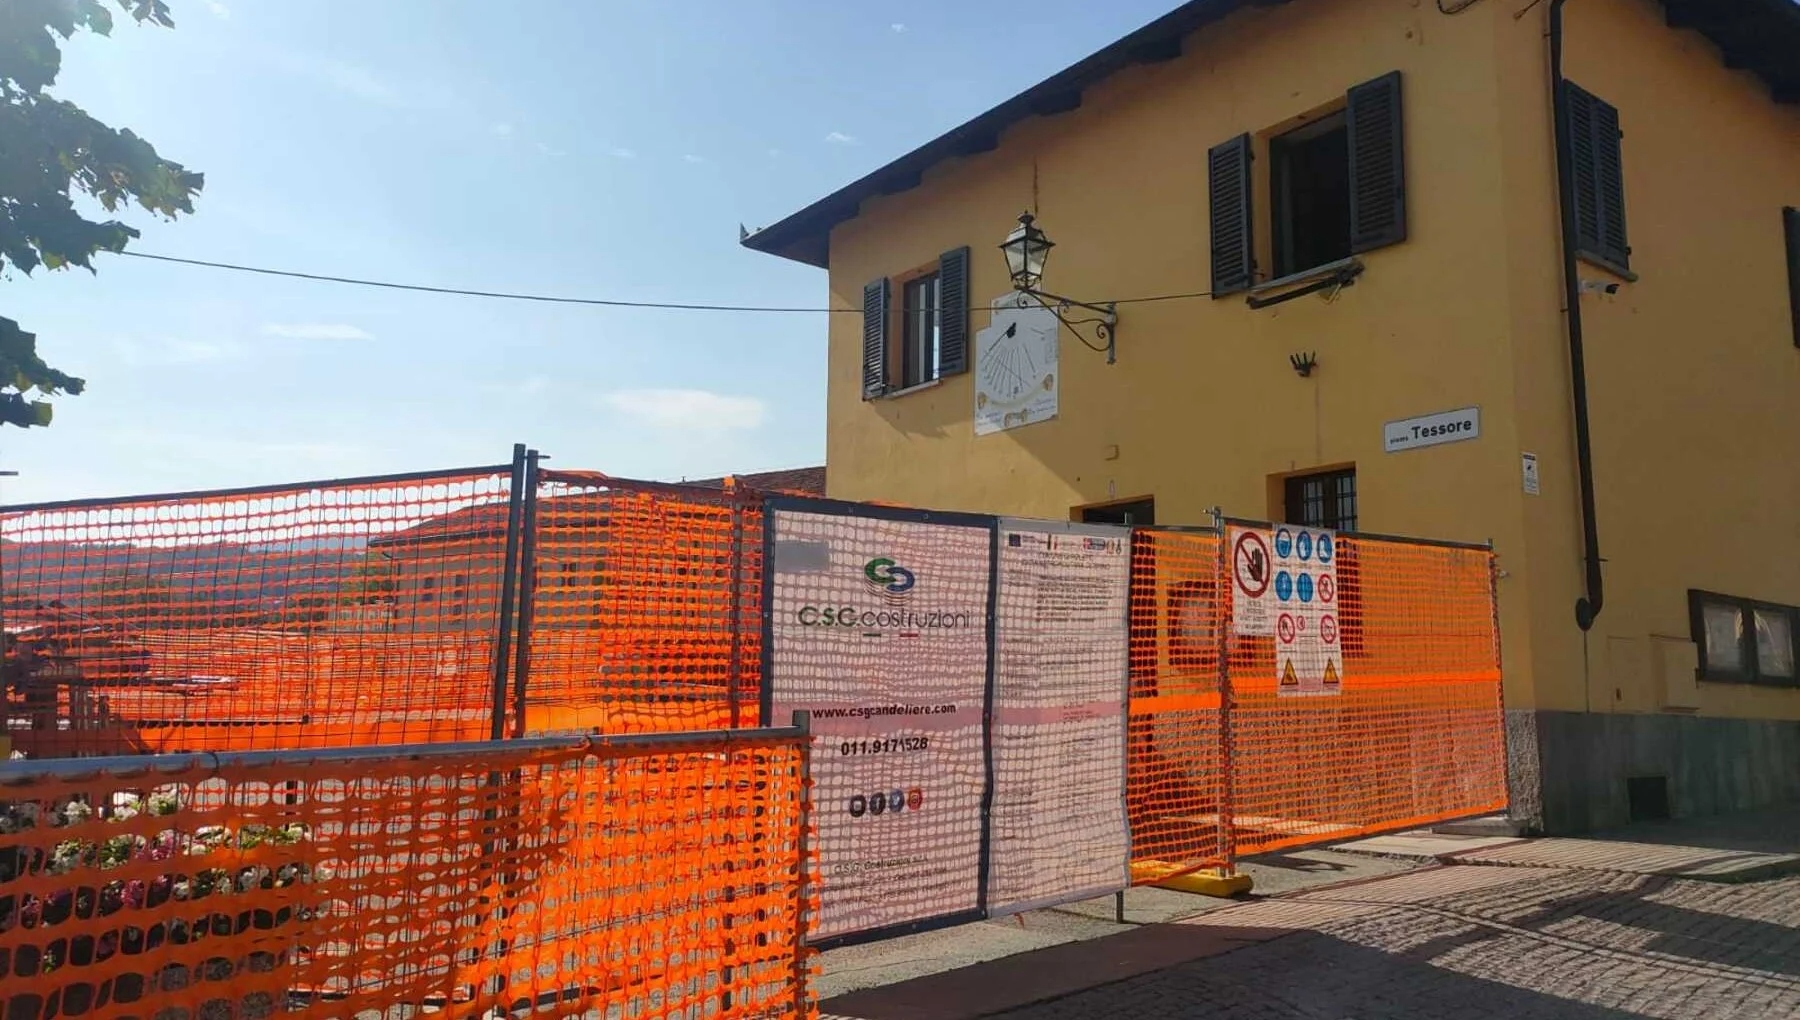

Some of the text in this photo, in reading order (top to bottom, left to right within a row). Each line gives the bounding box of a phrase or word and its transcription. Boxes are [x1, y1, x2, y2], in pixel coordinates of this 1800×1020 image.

[1411, 420, 1472, 439] Tessore
[812, 704, 956, 719] www.csgcandeliere.com
[841, 737, 929, 756] 011.9171528
